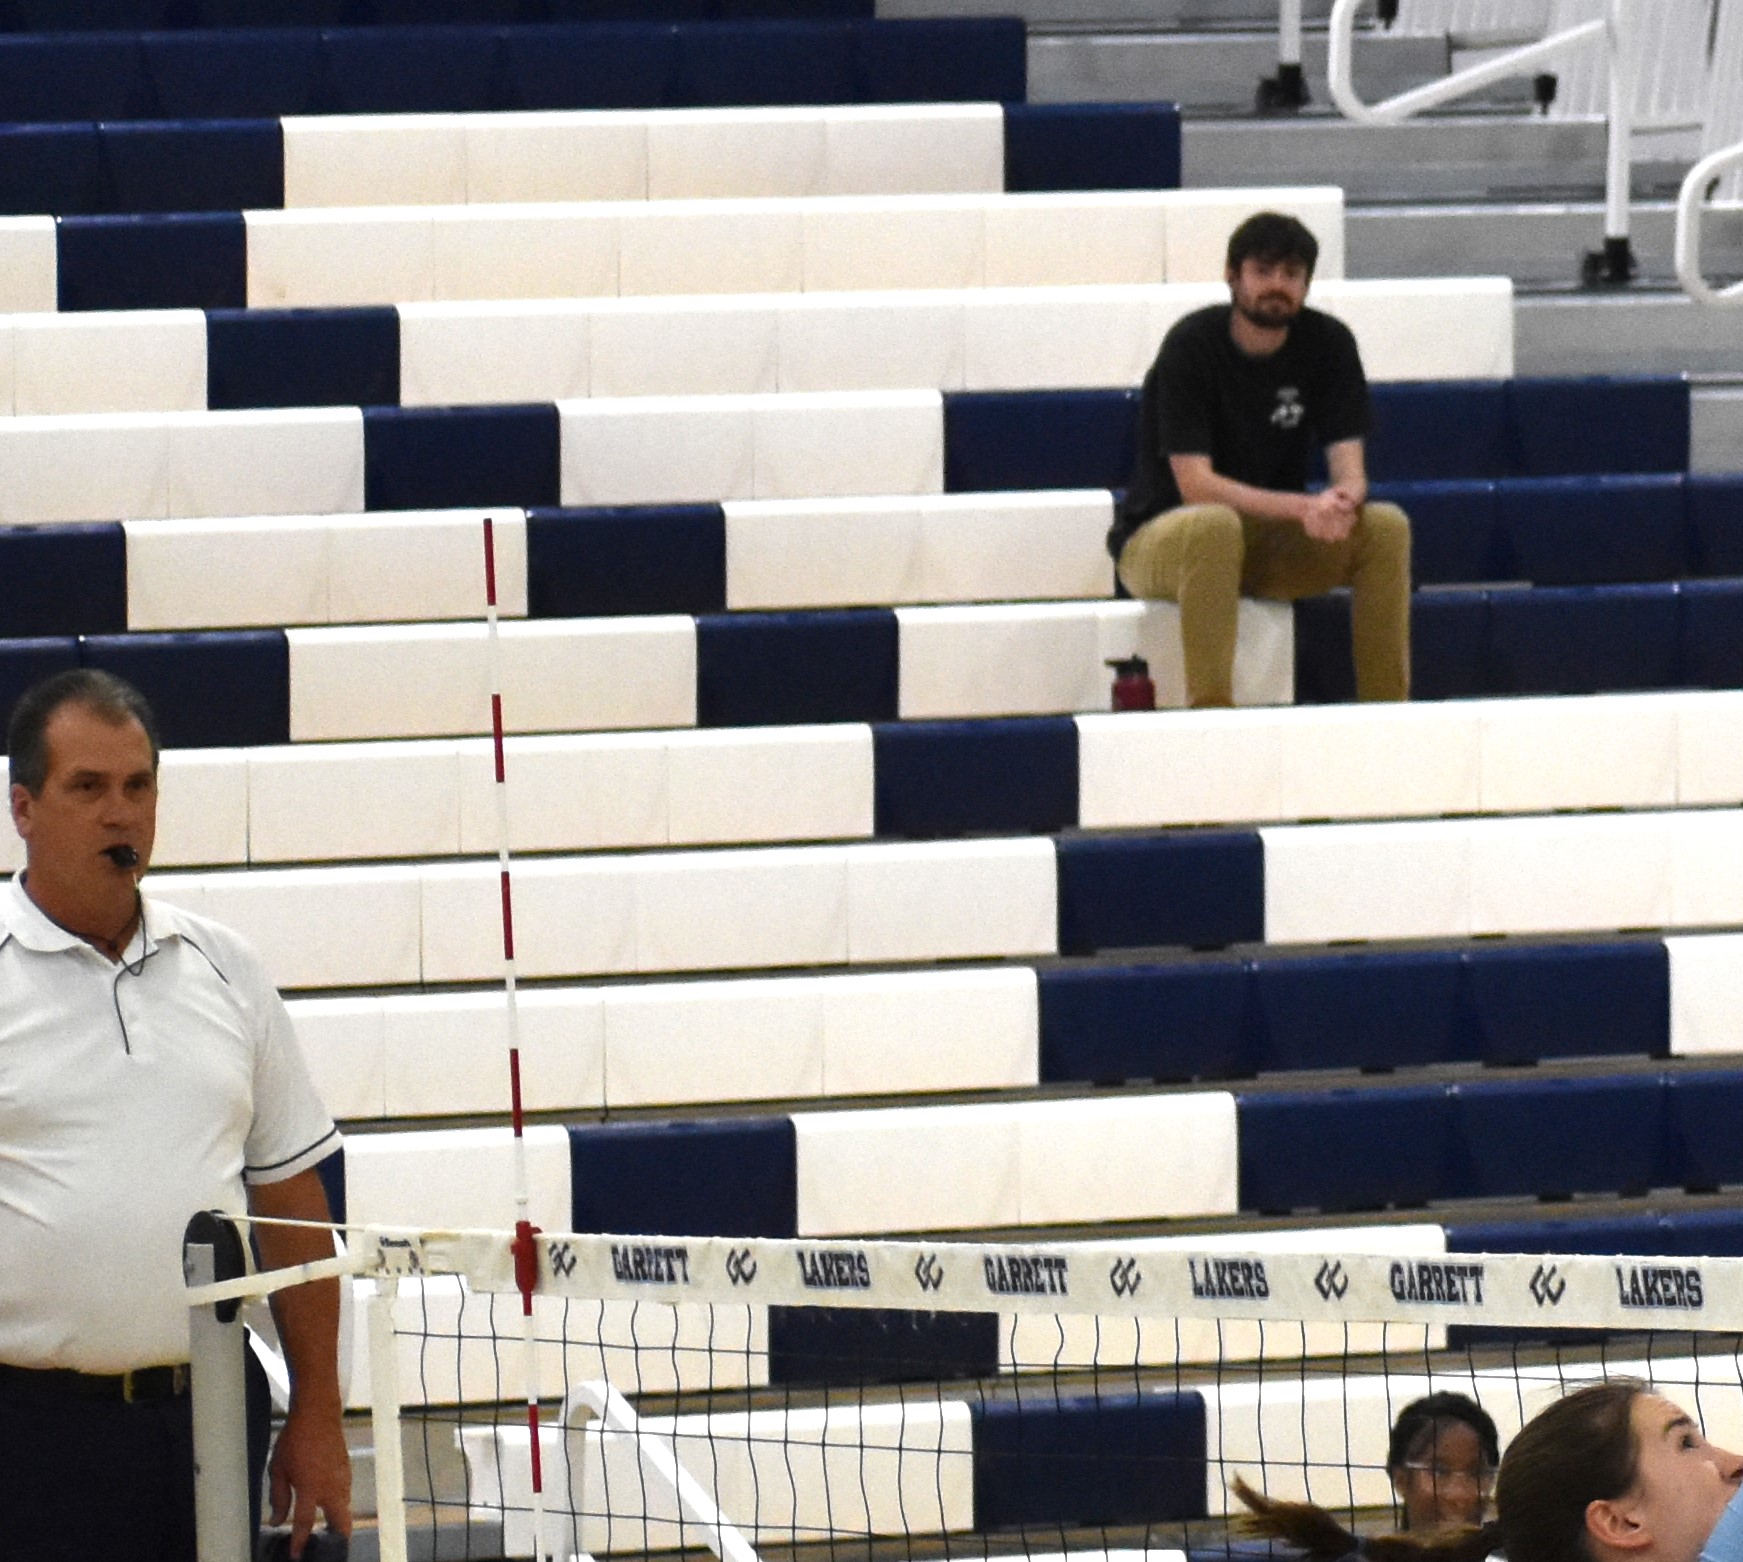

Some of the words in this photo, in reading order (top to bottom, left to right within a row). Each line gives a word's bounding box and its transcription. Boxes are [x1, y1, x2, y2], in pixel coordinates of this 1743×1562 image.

[609, 1244, 692, 1287] GARRETT
[795, 1250, 874, 1293] LAKERS
[982, 1255, 1071, 1298] GARRETT
[1187, 1259, 1273, 1303] LAKERS
[1388, 1262, 1487, 1308] GARRETT
[1614, 1267, 1707, 1312] LAKERS
